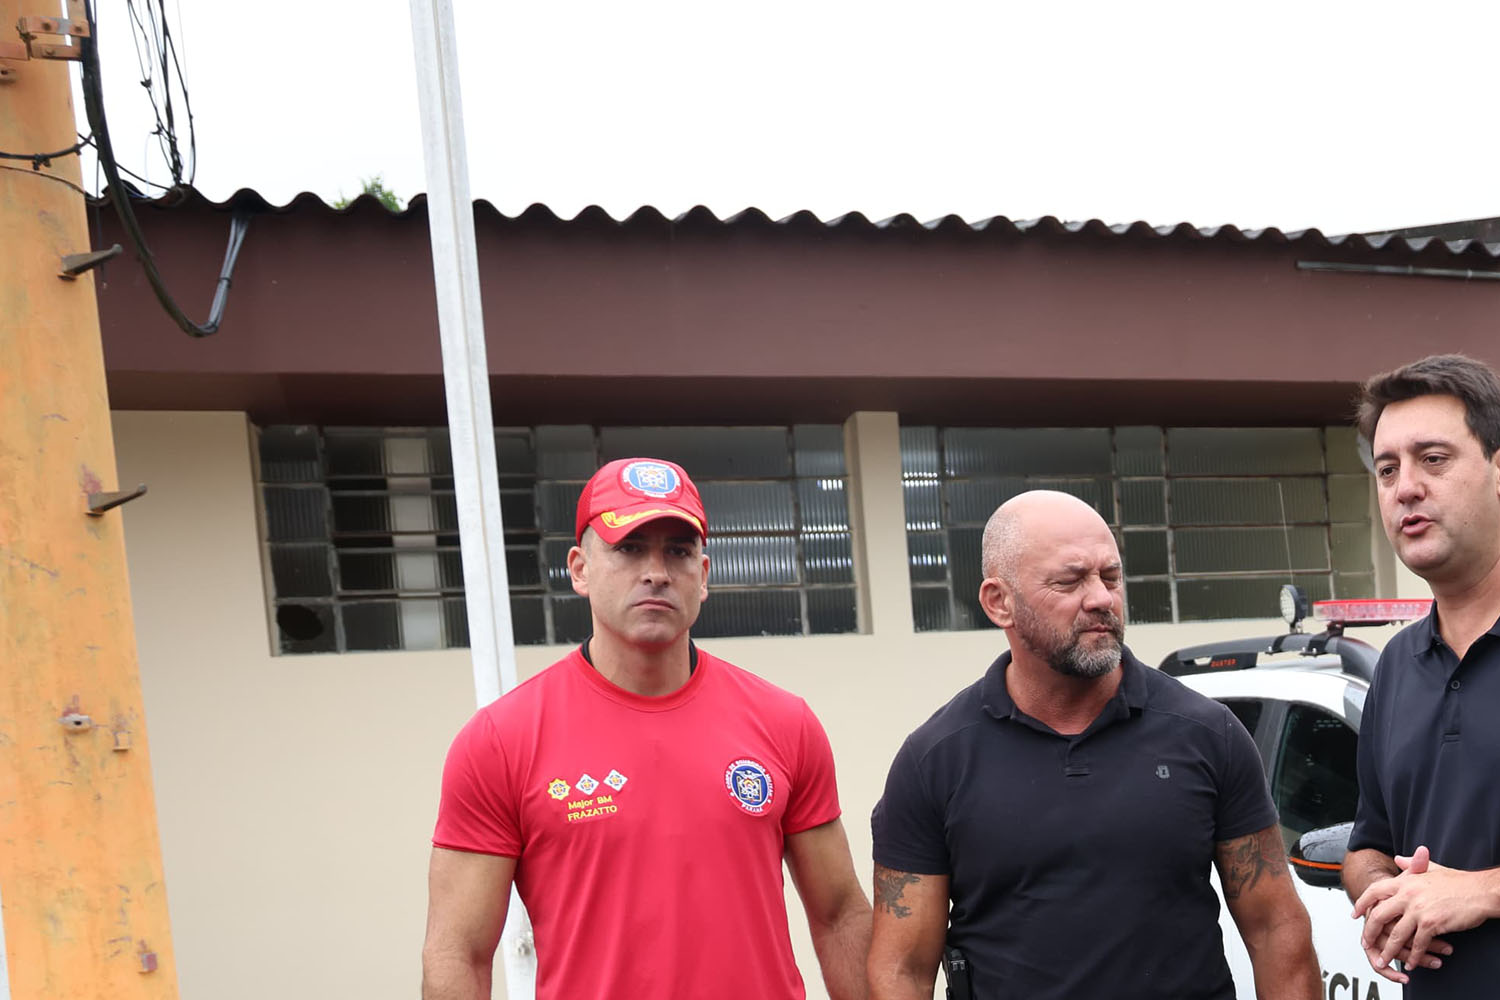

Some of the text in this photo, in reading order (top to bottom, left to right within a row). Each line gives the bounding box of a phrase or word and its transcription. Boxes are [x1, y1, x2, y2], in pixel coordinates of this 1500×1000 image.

[567, 794, 613, 810] Major BM
[567, 805, 618, 822] FRAZATTO
